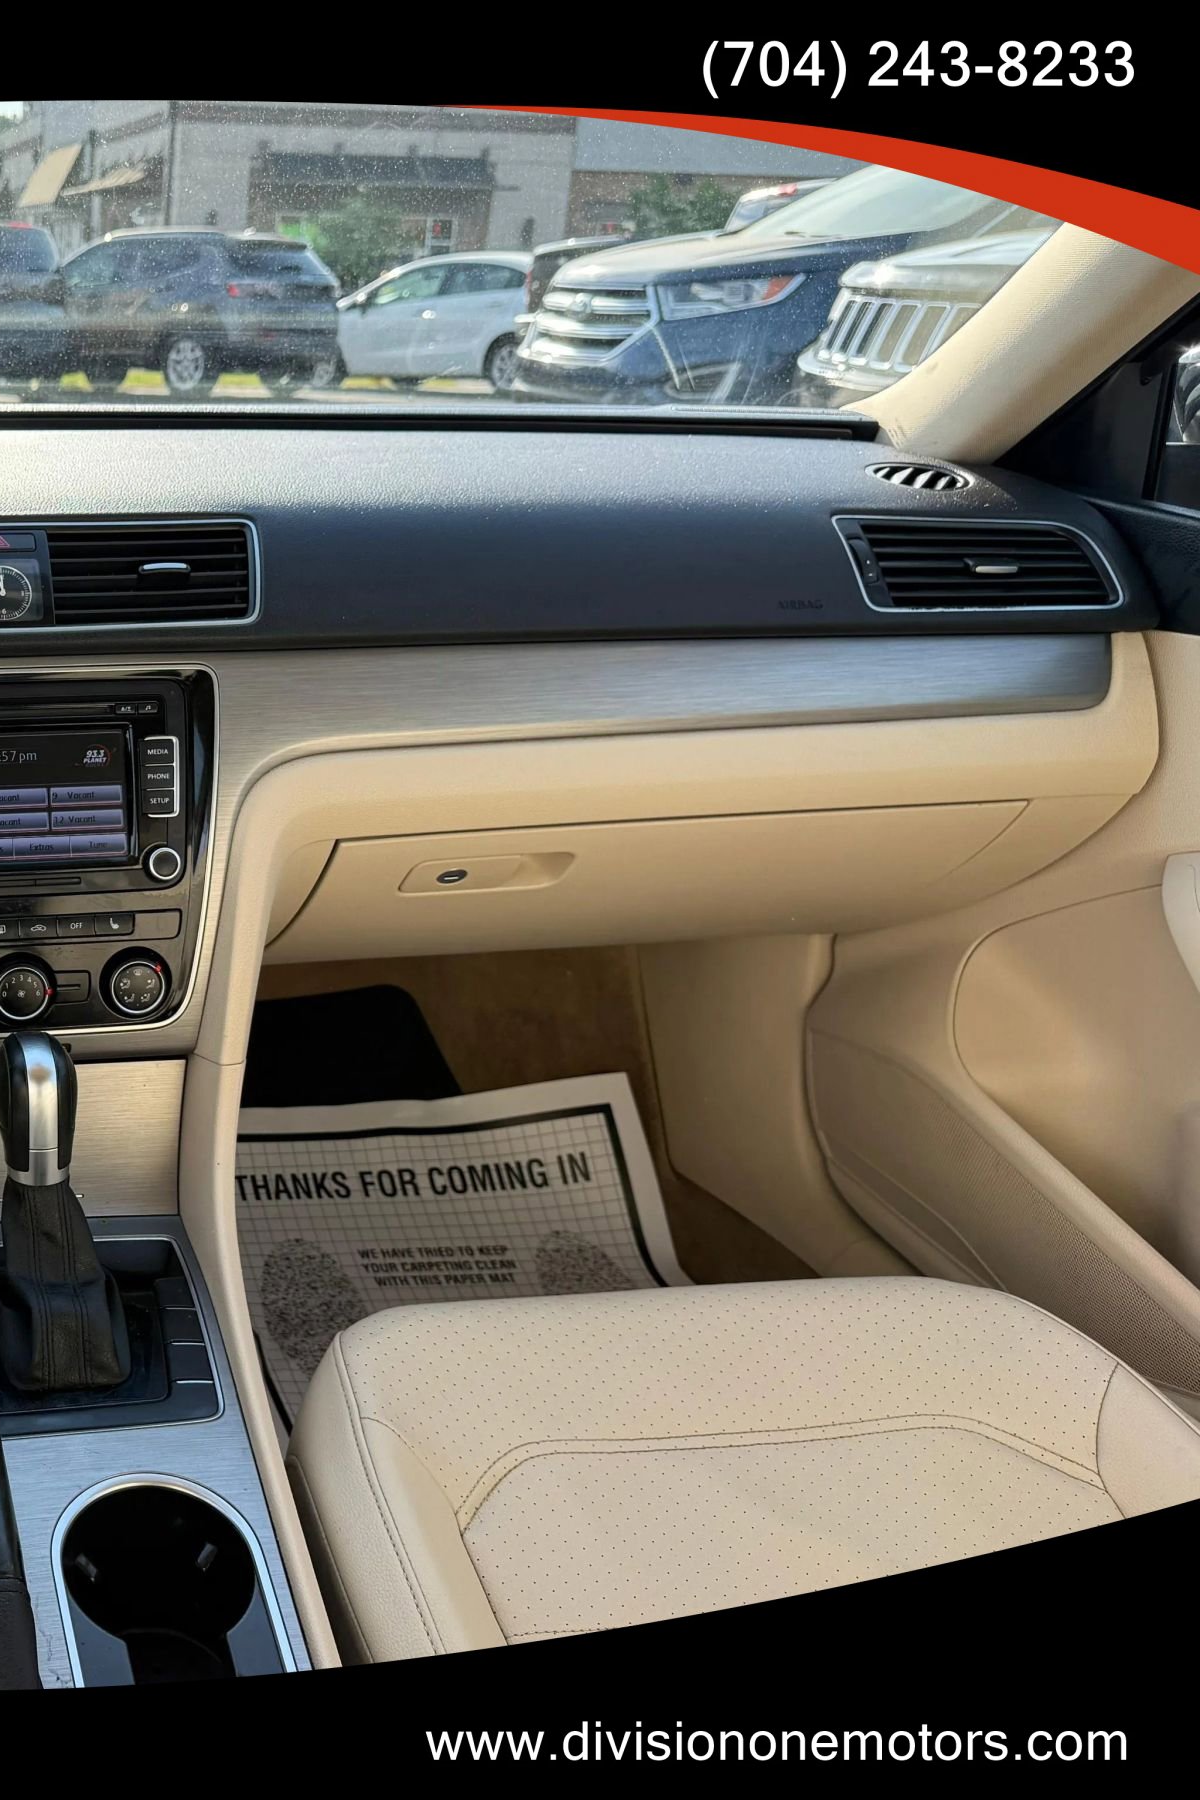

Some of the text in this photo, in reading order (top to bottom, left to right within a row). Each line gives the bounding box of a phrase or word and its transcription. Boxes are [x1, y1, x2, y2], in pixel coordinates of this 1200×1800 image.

[86, 750, 105, 758] 93.3
[52, 790, 95, 800] 9 Vacant
[149, 797, 170, 805] SETUP
[68, 814, 96, 824] Vacant
[29, 843, 54, 852] Extras
[70, 922, 84, 930] OFF
[235, 1151, 593, 1202] THANKS FOR COMING IN
[357, 1244, 508, 1259] WE HAVE TRIED TO KEEP
[362, 1259, 518, 1272] YOUR CARPETING CLEAN
[374, 1272, 516, 1286] WITH THIS PAPER MAT
